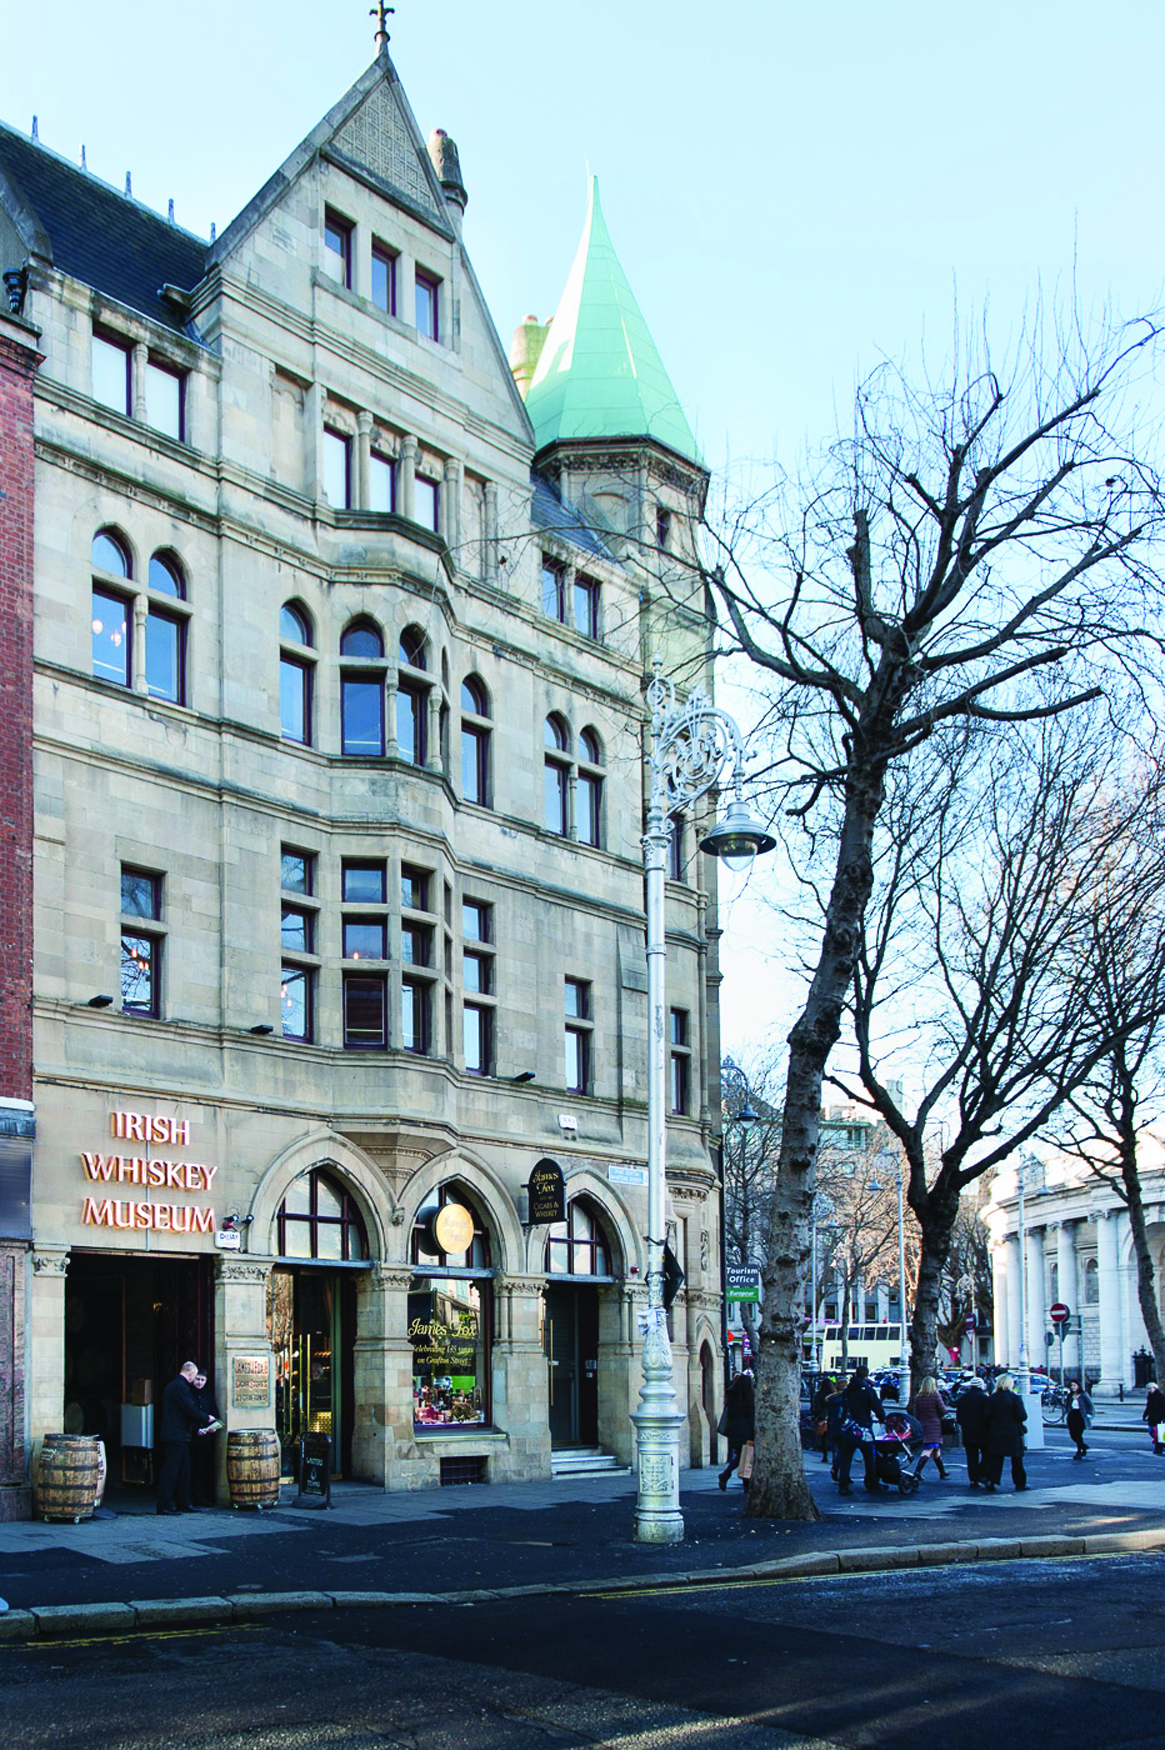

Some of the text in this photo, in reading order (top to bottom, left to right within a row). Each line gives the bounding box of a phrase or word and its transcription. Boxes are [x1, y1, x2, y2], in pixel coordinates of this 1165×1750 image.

[111, 1111, 190, 1146] IRISH
[81, 1152, 218, 1190] WHISKEY
[536, 1182, 556, 1195] Fox
[81, 1197, 217, 1233] MUSEUM
[408, 1317, 476, 1337] James Fox
